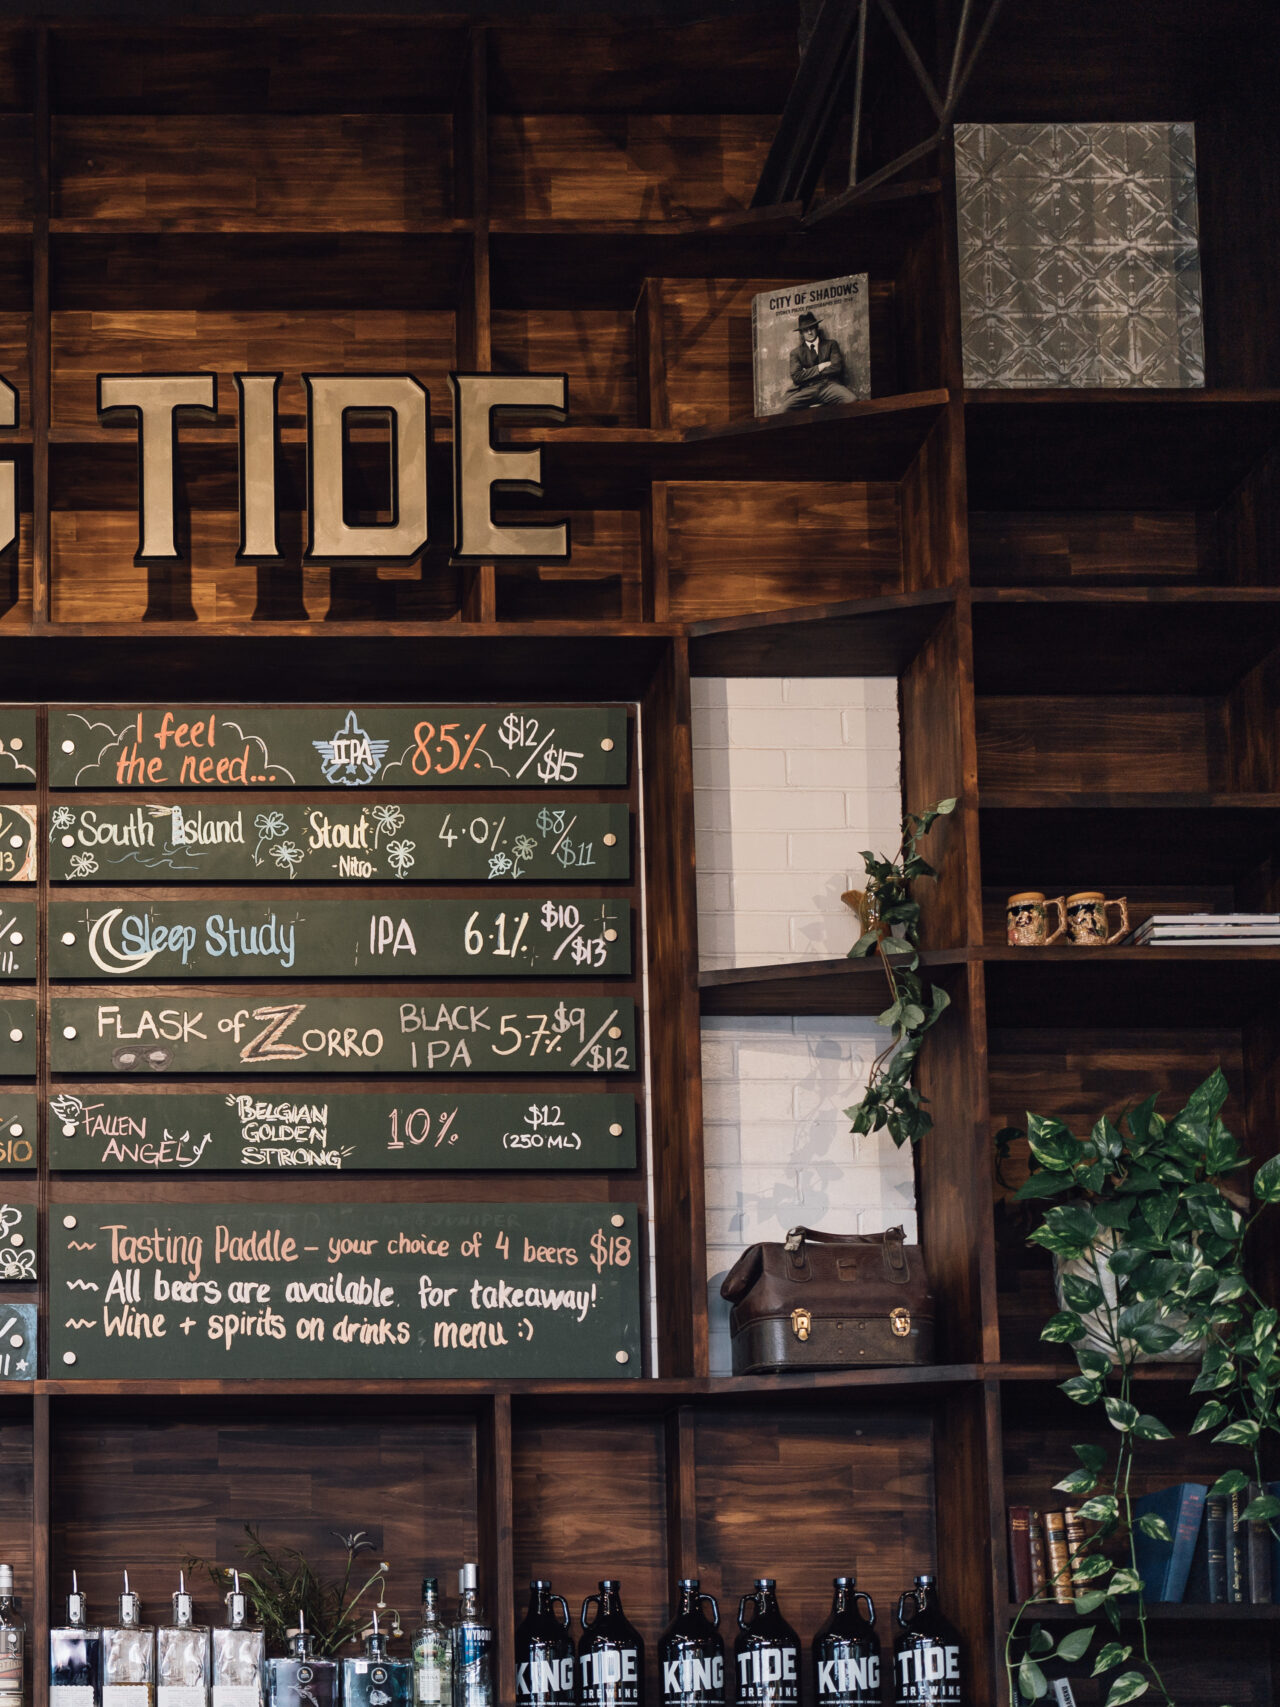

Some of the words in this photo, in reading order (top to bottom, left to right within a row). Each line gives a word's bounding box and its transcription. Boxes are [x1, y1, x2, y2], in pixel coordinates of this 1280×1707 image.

[770, 294, 791, 310] CITY
[794, 292, 806, 305] OF
[809, 282, 859, 302] SHADOWS
[97, 371, 570, 561] TIDE
[154, 712, 217, 750] feel
[117, 744, 169, 784] the
[77, 810, 154, 847] South
[171, 806, 245, 845] Island
[310, 811, 370, 851] Stout
[121, 914, 197, 965] Sleep
[205, 914, 296, 967] Study
[370, 915, 417, 955] IPA
[98, 1006, 207, 1042] FLASK
[218, 1010, 250, 1042] of
[401, 1003, 491, 1033] BLACK
[412, 1040, 472, 1069] IPA
[81, 1103, 147, 1139] FALLEN
[237, 1094, 329, 1124] BELGIAN
[524, 1105, 565, 1129] $12
[241, 1122, 327, 1149] GOLDEN
[387, 1108, 460, 1149] 10%
[102, 1137, 194, 1168] ANGEL
[241, 1146, 342, 1169] STRONG
[99, 1224, 203, 1280] Tasting
[215, 1225, 299, 1264] Paddle
[328, 1235, 376, 1269] your
[387, 1232, 450, 1257] choice
[460, 1231, 483, 1258] of
[495, 1230, 510, 1260] 4
[523, 1233, 579, 1265] beers
[590, 1228, 632, 1273] $18
[104, 1269, 141, 1304] All
[154, 1271, 222, 1304] beers
[229, 1279, 270, 1304] are
[418, 1275, 458, 1310] for
[471, 1278, 597, 1322] takeaway!
[104, 1307, 167, 1338] Wine
[180, 1317, 197, 1336] +
[208, 1310, 286, 1350] spirits
[296, 1318, 325, 1342] on
[332, 1315, 411, 1345] drinks
[434, 1319, 508, 1349] menu
[516, 1658, 574, 1695] KING
[580, 1649, 638, 1687] TIDE
[663, 1656, 724, 1694] KING
[737, 1648, 797, 1685] TIDE
[818, 1655, 880, 1694] KING
[898, 1646, 960, 1684] TIDE
[582, 1688, 638, 1699] BREWING
[741, 1687, 798, 1697] BREWING
[902, 1686, 961, 1697] BREWING
